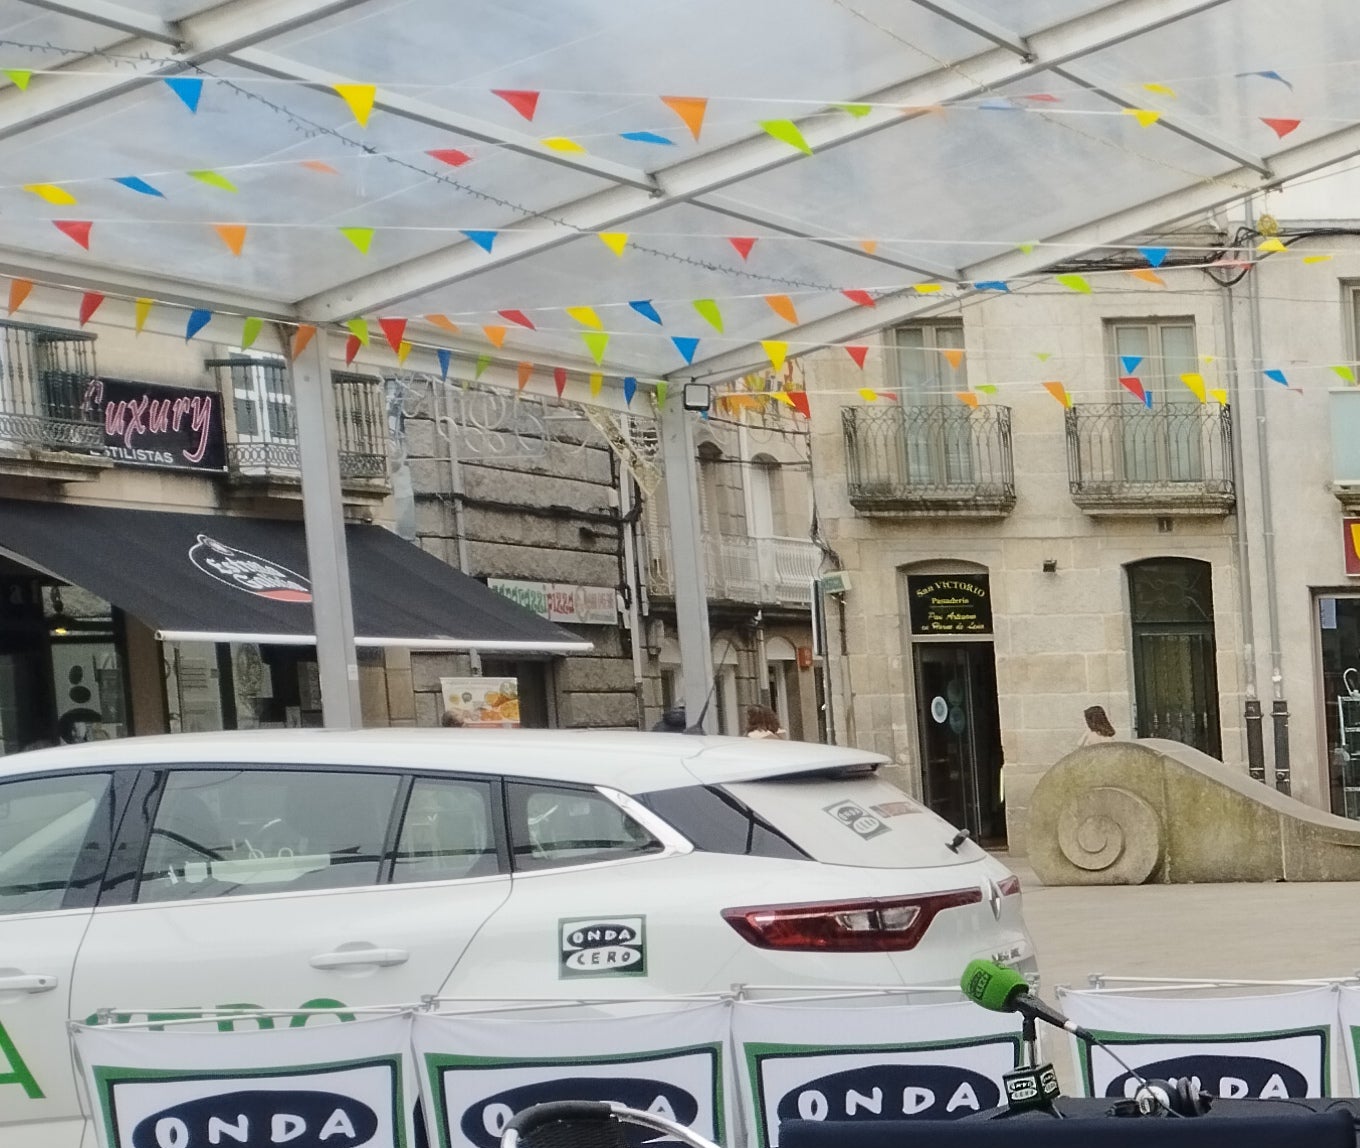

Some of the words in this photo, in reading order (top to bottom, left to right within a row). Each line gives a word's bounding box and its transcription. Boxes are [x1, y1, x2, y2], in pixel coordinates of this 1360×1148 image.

[90, 445, 174, 464] STILISTAS
[934, 580, 986, 598] VICTORIO
[572, 928, 631, 944] ONDA
[576, 951, 631, 966] CERO
[797, 1081, 981, 1122] ONDA
